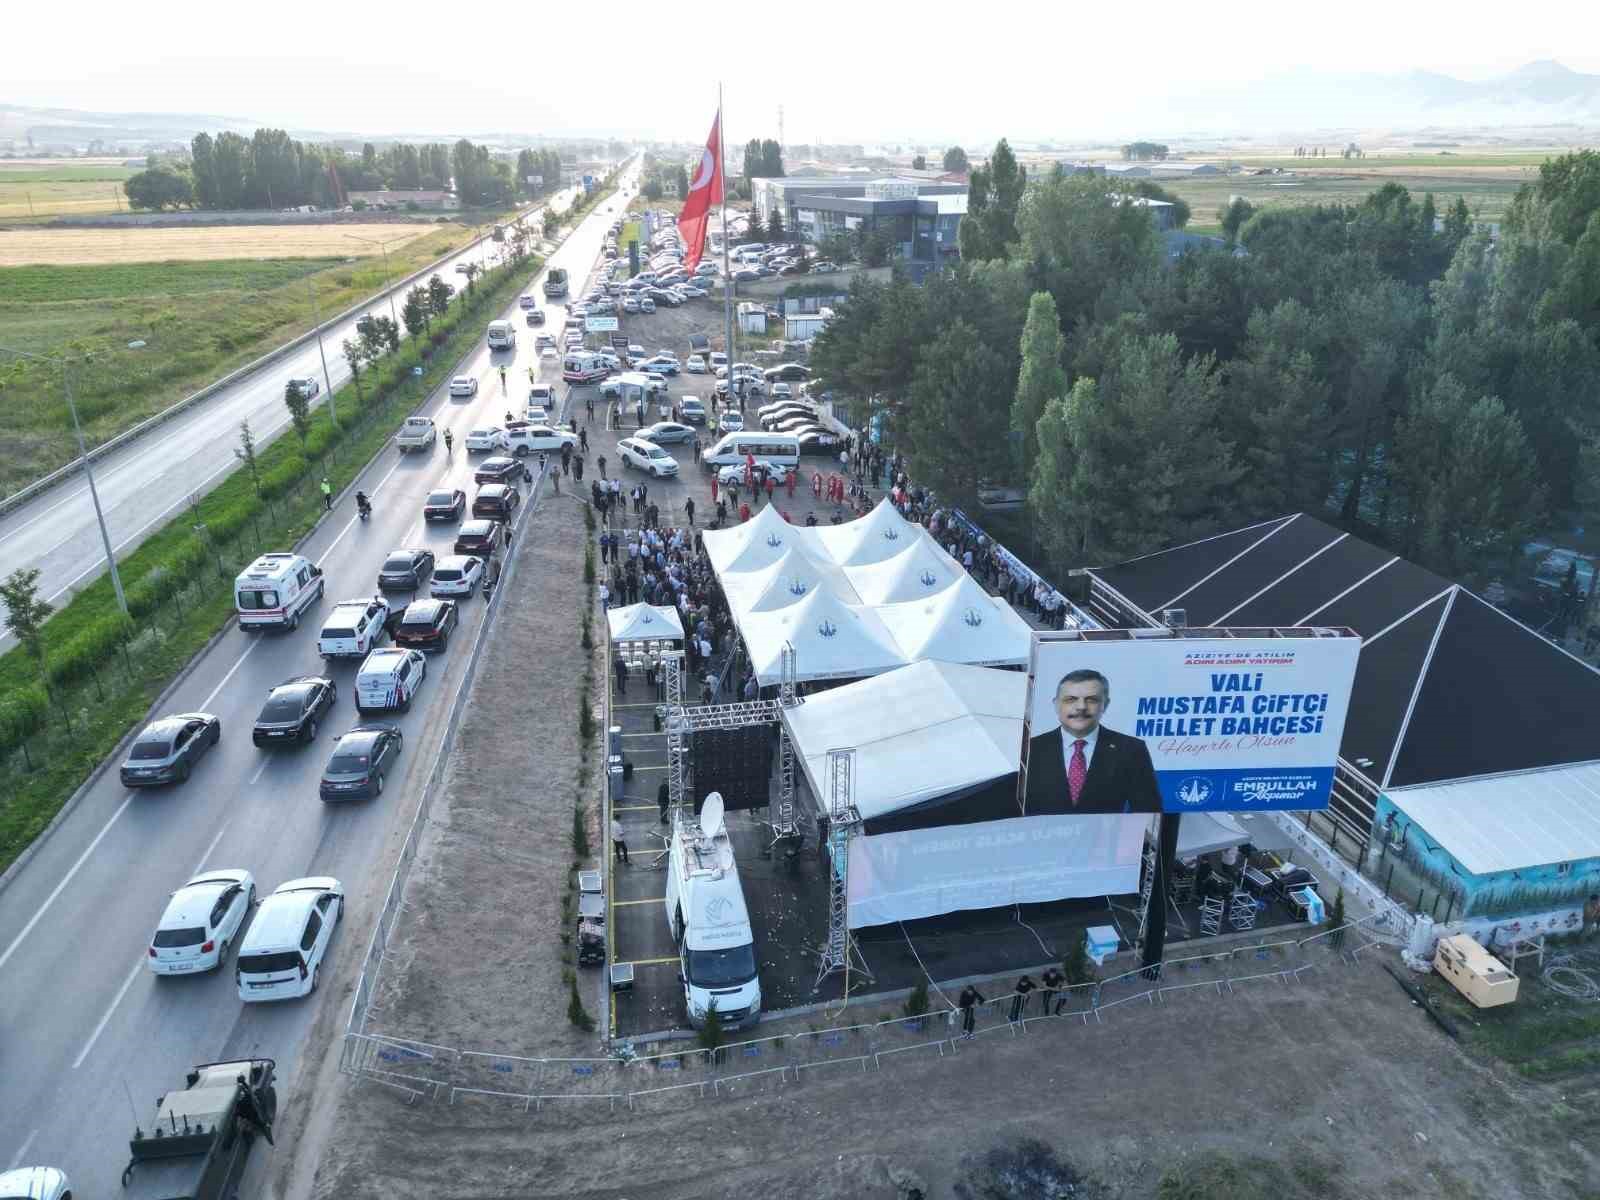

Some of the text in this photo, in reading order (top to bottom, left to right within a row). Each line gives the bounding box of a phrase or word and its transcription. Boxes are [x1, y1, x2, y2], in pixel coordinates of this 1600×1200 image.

[1136, 695, 1245, 715] MUSTAFA
[1236, 734, 1296, 750] Olsun
[1234, 781, 1318, 792] EMRULLAH
